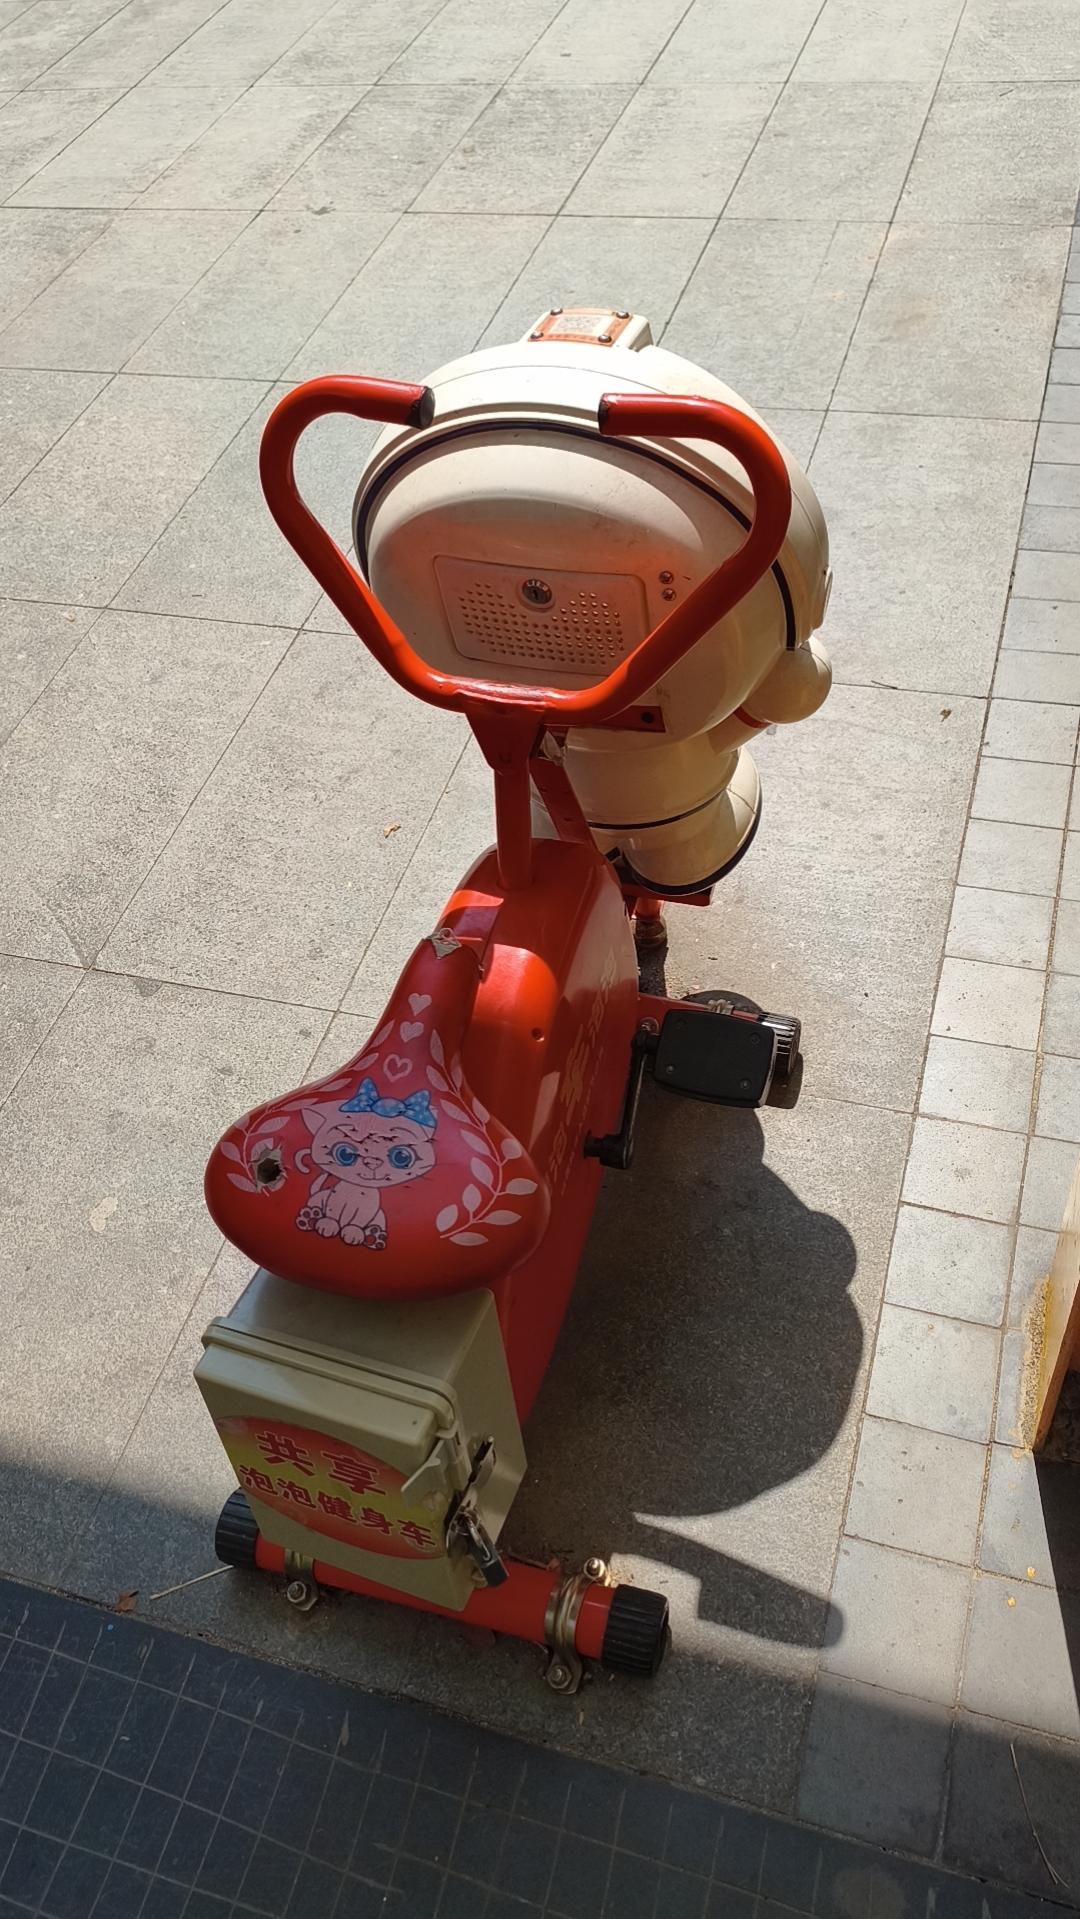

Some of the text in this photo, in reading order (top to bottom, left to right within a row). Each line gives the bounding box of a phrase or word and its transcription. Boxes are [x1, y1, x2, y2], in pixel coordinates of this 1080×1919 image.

[255, 1431, 386, 1496] 共享
[239, 1464, 437, 1547] 泡泡健身车
